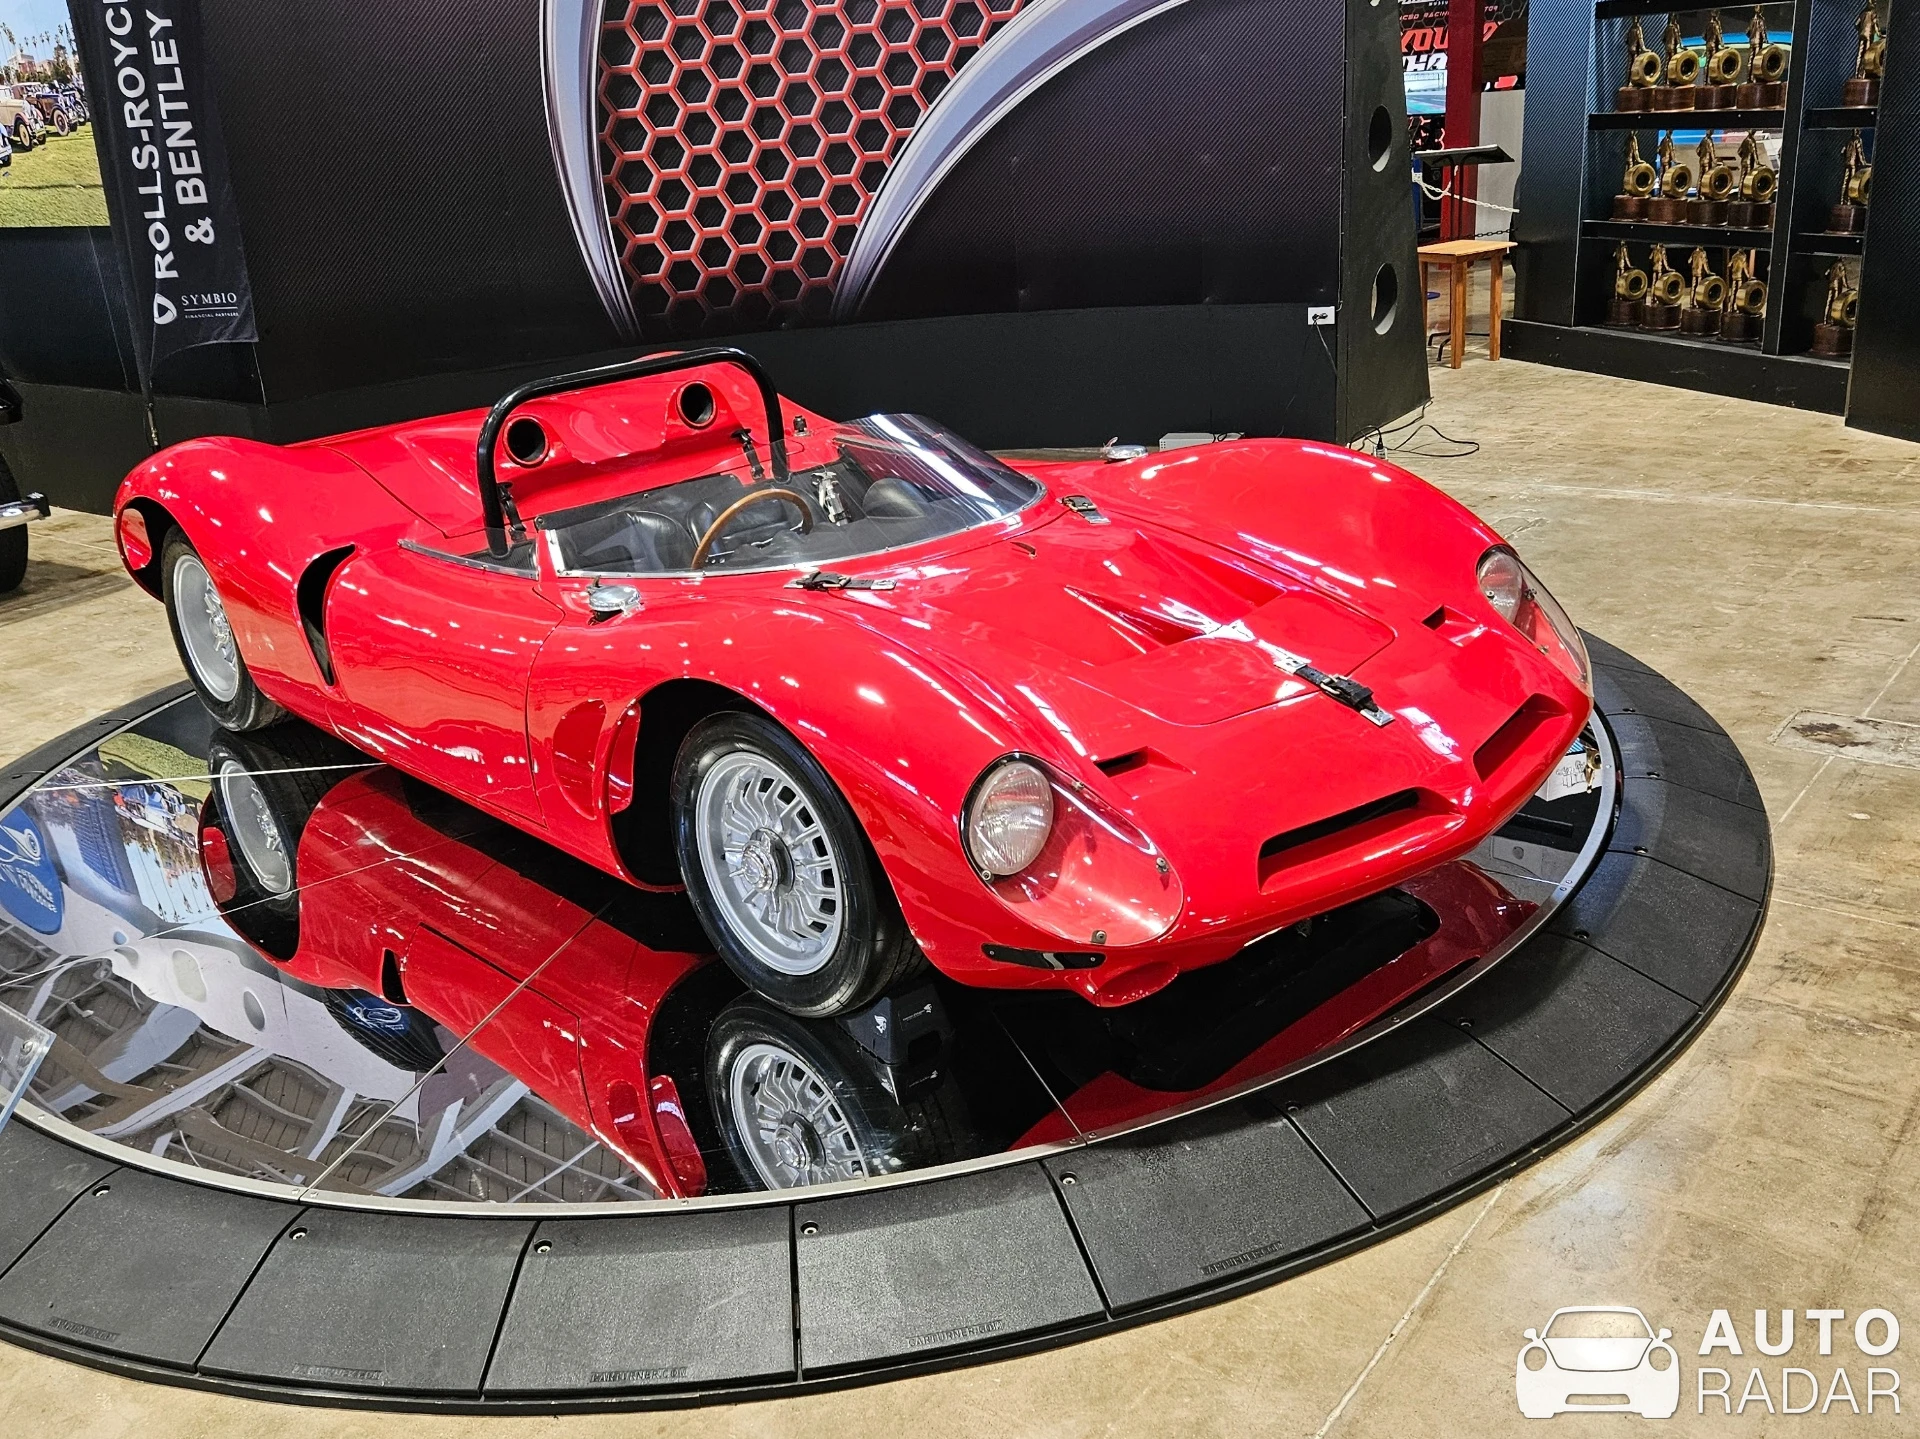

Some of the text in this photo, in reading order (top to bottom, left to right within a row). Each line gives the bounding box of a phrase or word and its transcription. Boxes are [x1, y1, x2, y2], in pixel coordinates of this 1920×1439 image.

[103, 0, 180, 279] ROLLS-ROYC
[145, 9, 215, 245] & BENTLEY
[181, 292, 237, 306] SYMBIO
